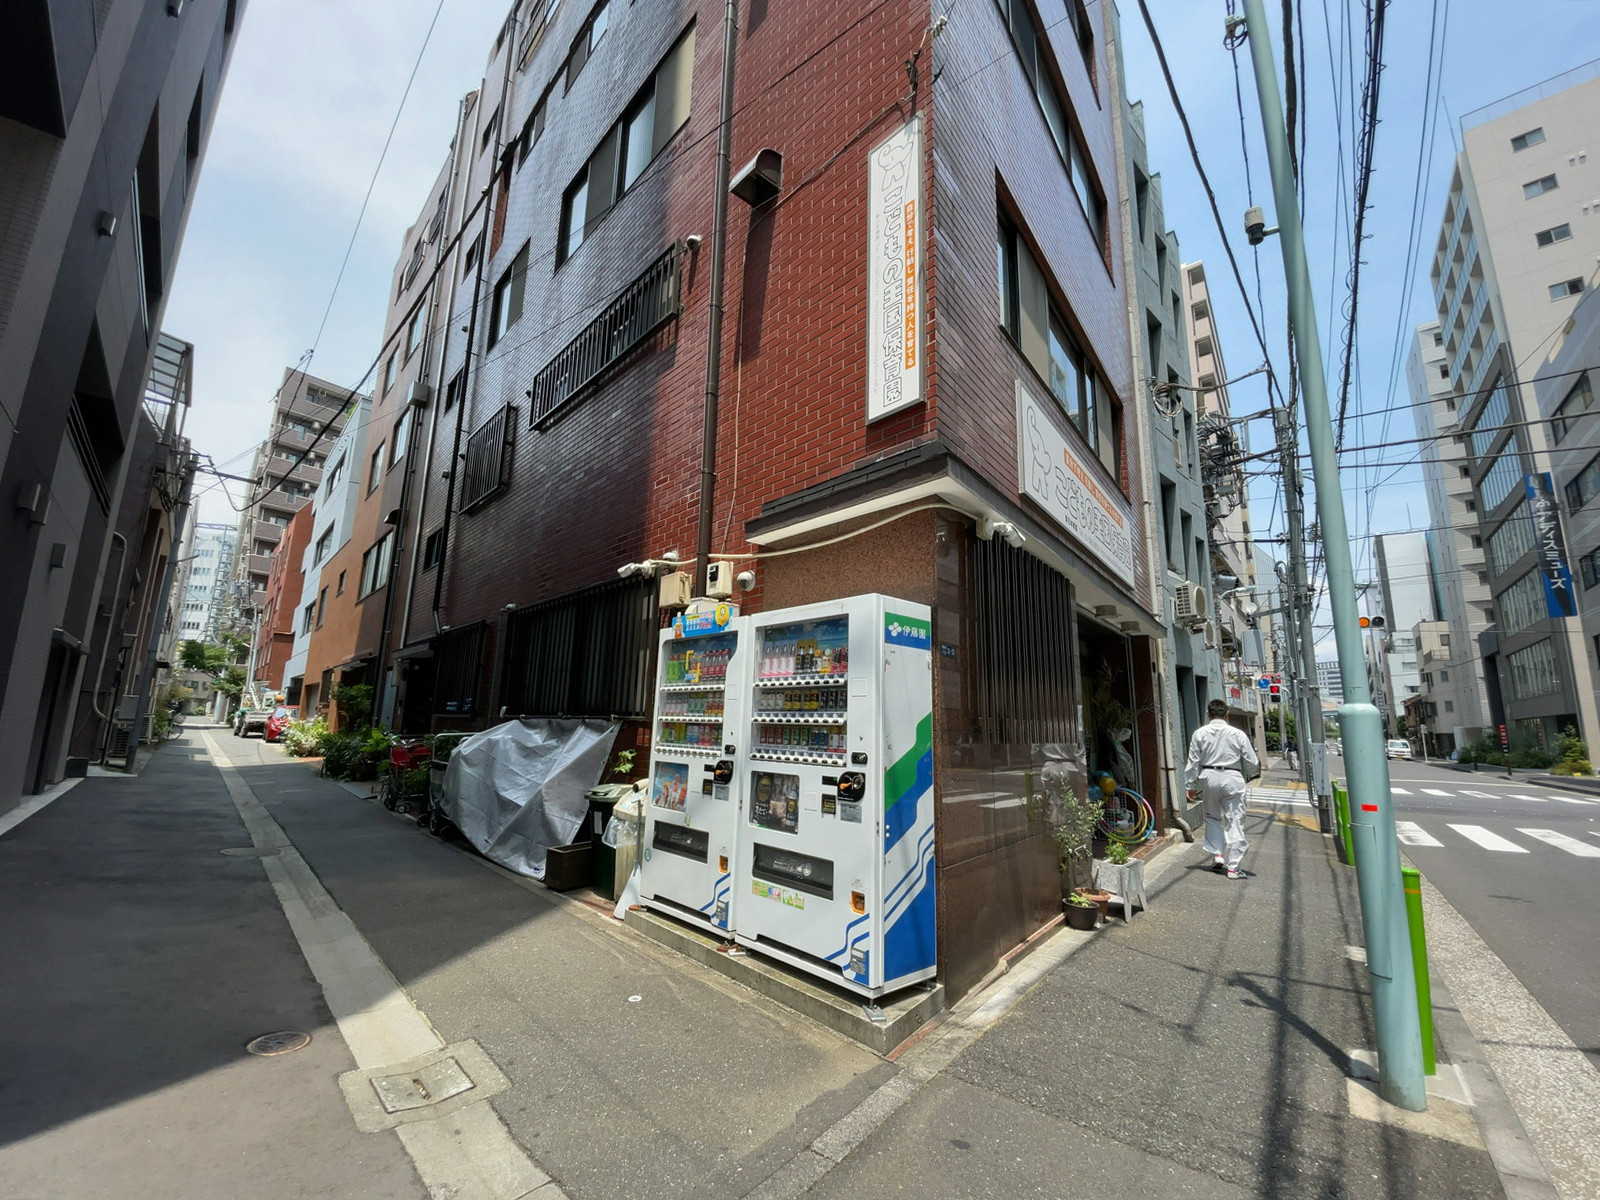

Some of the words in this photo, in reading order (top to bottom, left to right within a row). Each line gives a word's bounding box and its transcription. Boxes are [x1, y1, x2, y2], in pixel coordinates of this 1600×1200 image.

[882, 185, 903, 407] こどもの王国保育園
[1055, 465, 1132, 572] こどもの王国保育園
[902, 625, 926, 640] 伊藤園
